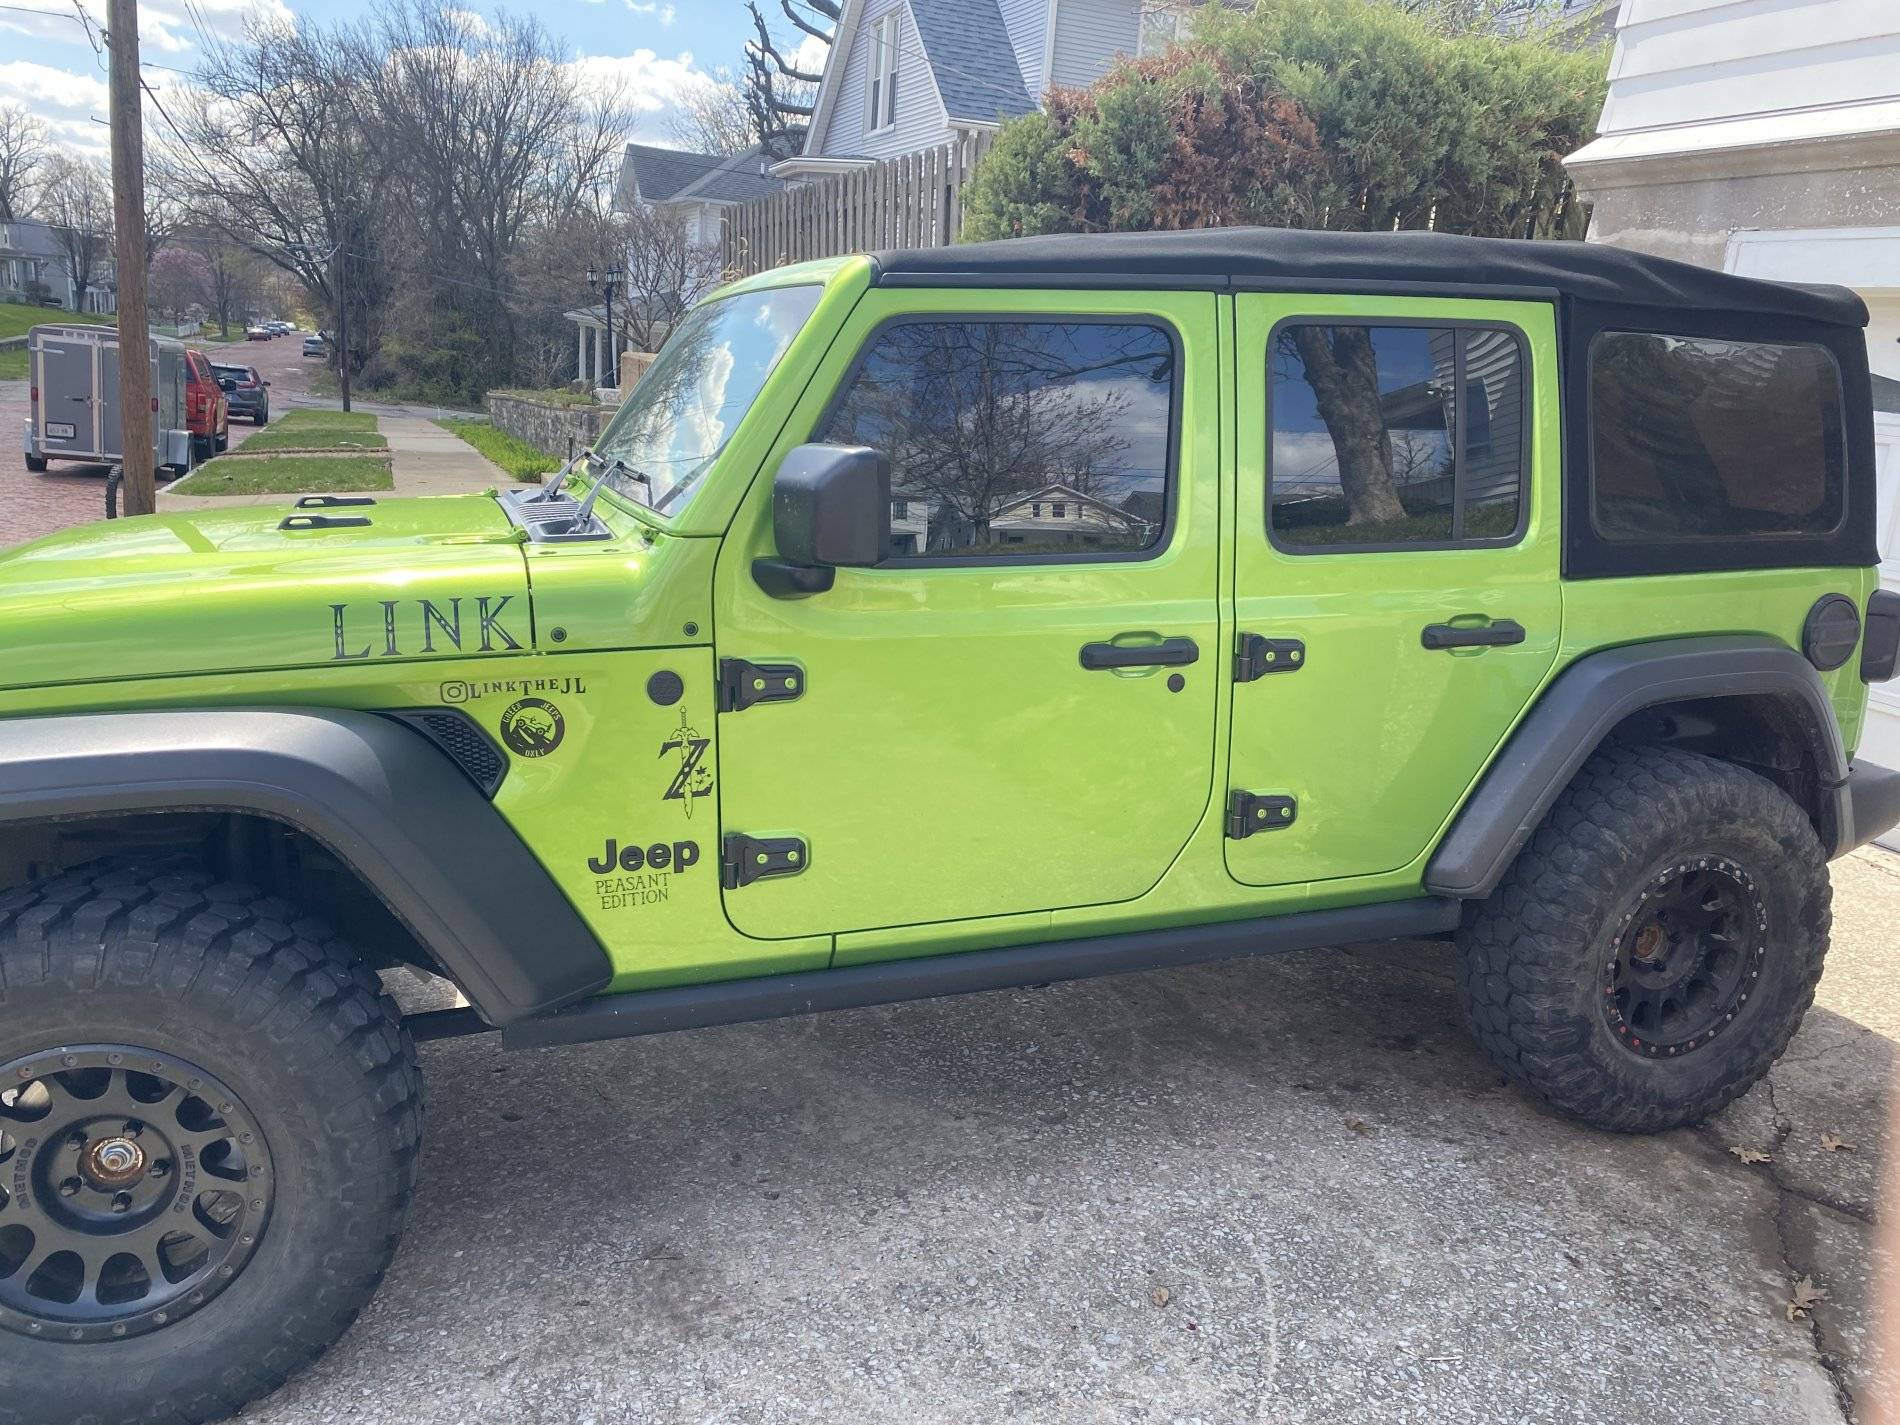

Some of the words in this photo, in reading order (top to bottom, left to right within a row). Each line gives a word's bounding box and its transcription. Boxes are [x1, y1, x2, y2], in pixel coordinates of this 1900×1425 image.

[328, 595, 525, 660] LINK
[540, 702, 561, 721] JEEPS
[588, 839, 700, 874] Jeep
[595, 872, 671, 894] PEASANT
[601, 888, 669, 910] EDITION
